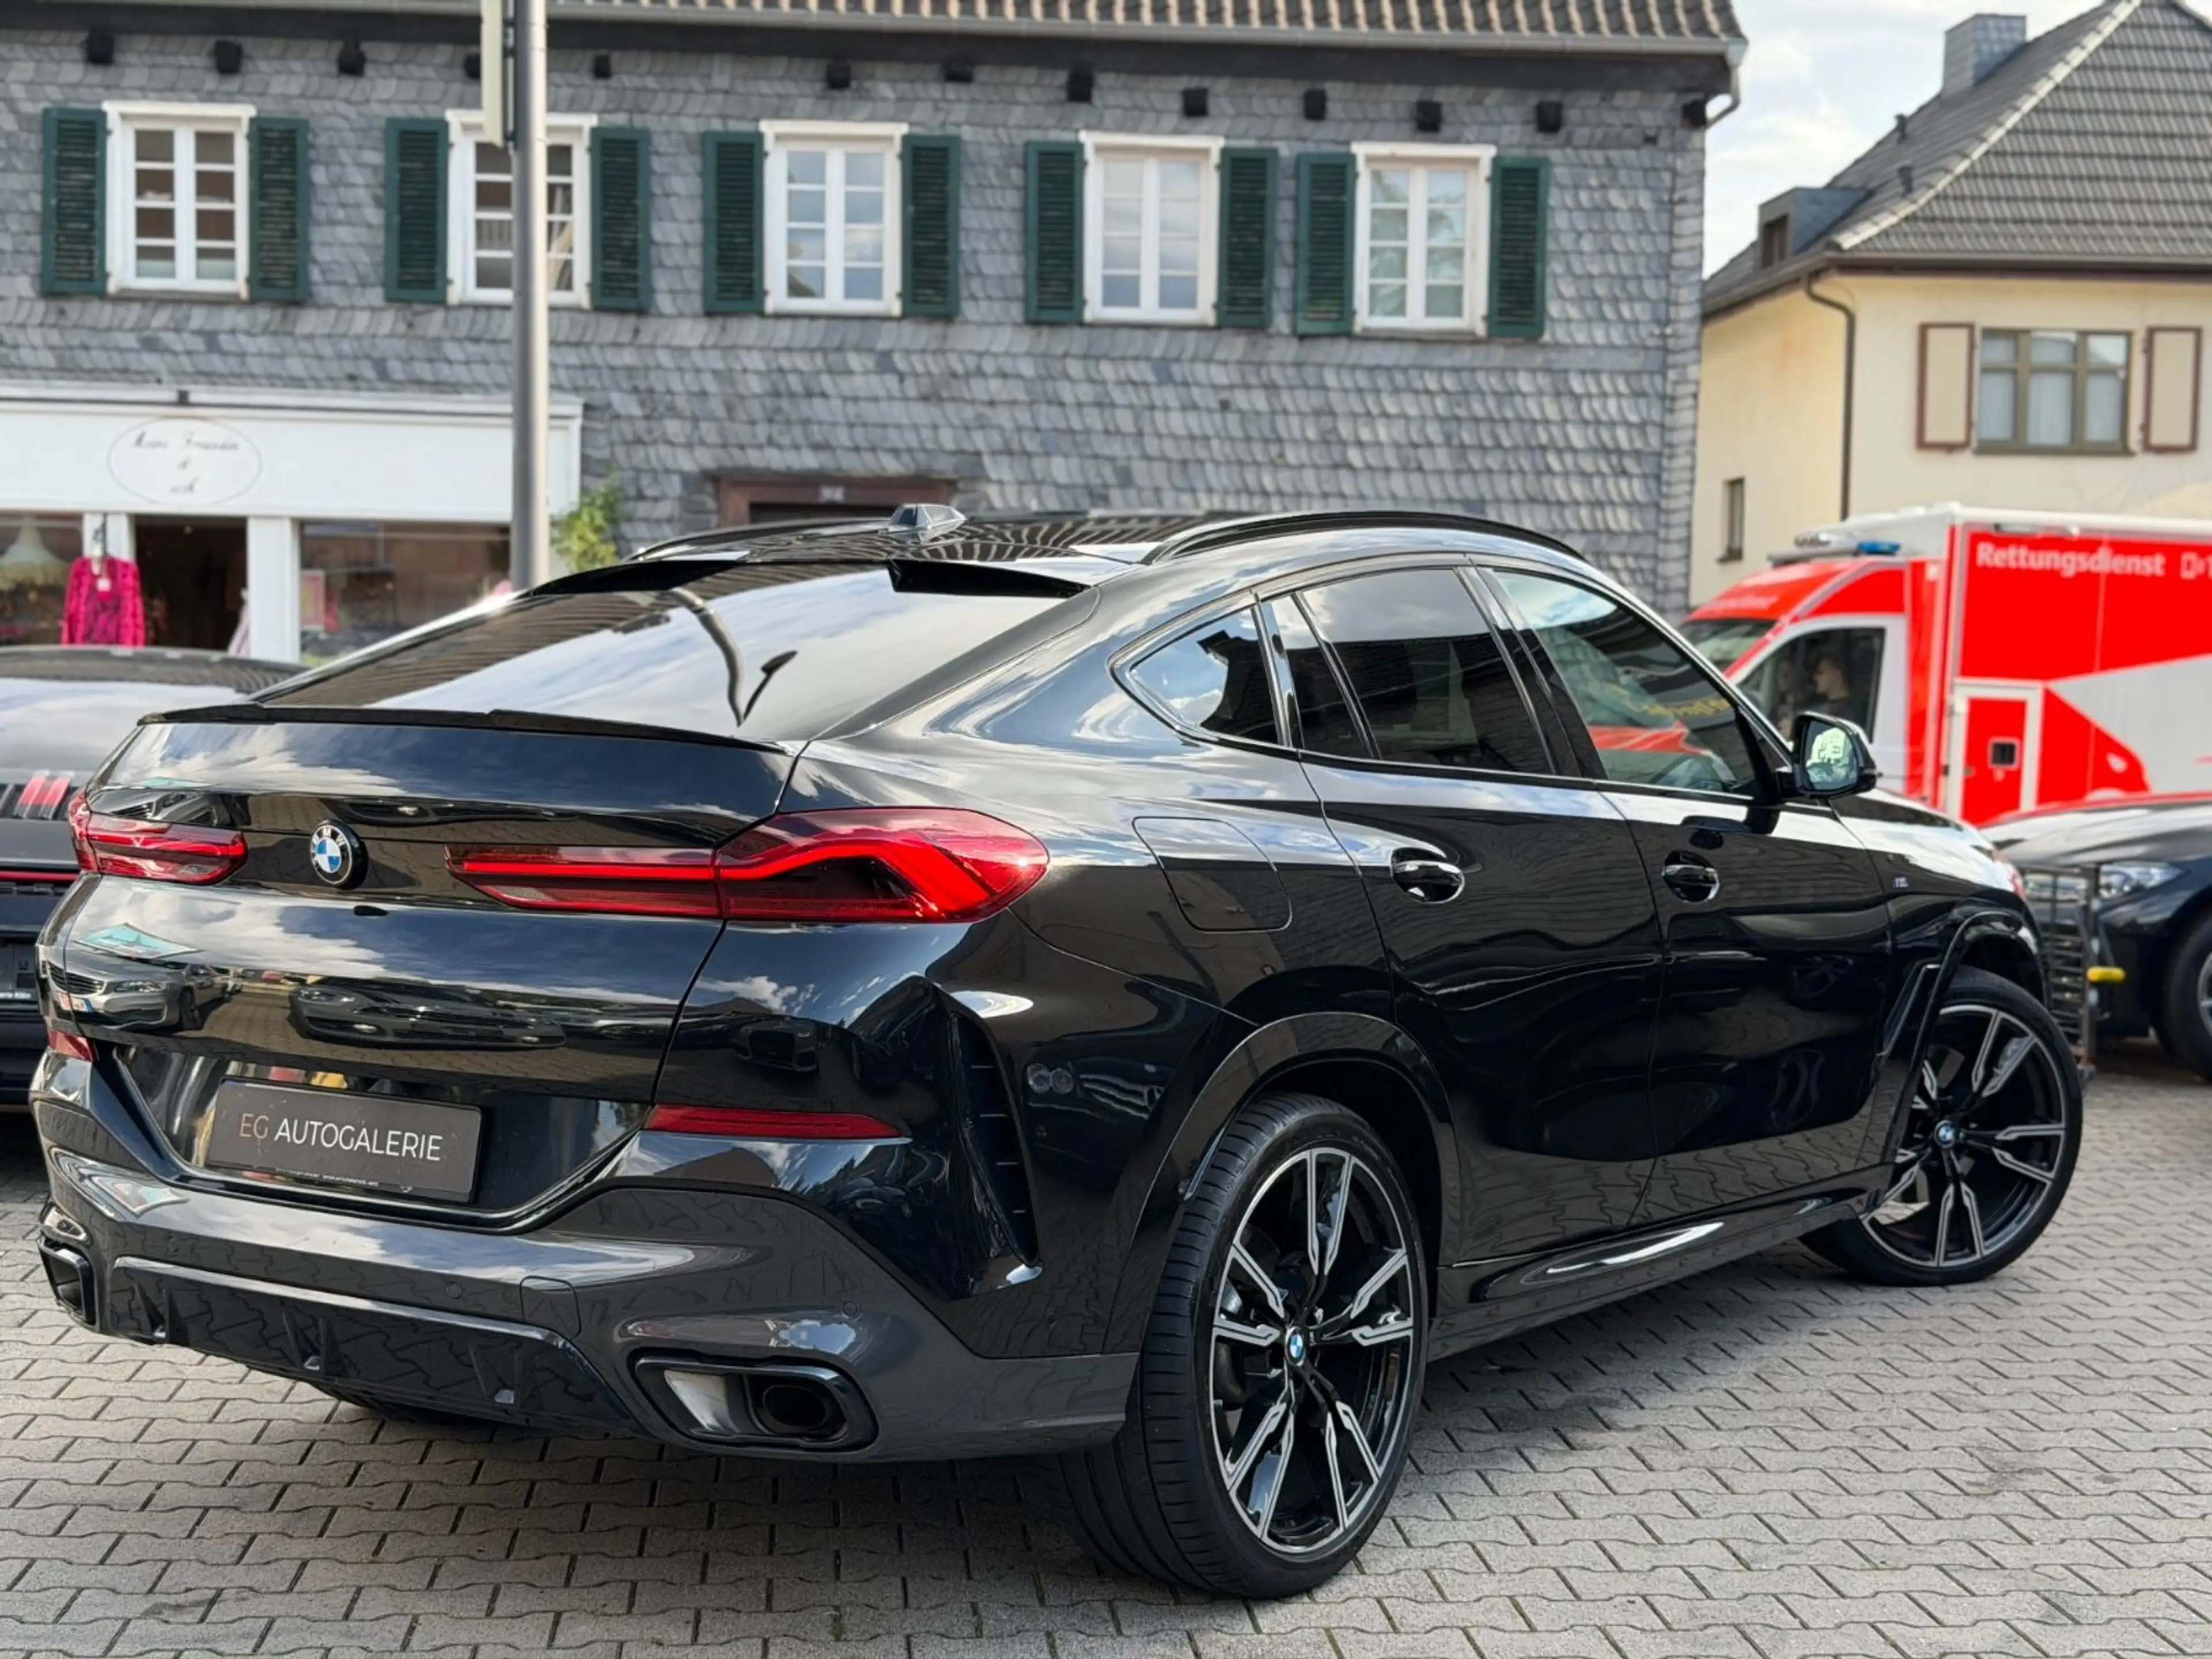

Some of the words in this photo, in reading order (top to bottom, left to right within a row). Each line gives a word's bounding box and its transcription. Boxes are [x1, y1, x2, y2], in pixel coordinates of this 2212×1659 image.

[1976, 541, 2166, 578] Rettungsdienst
[238, 1112, 270, 1139] EG
[274, 1118, 444, 1161] AUTOGALERIE
